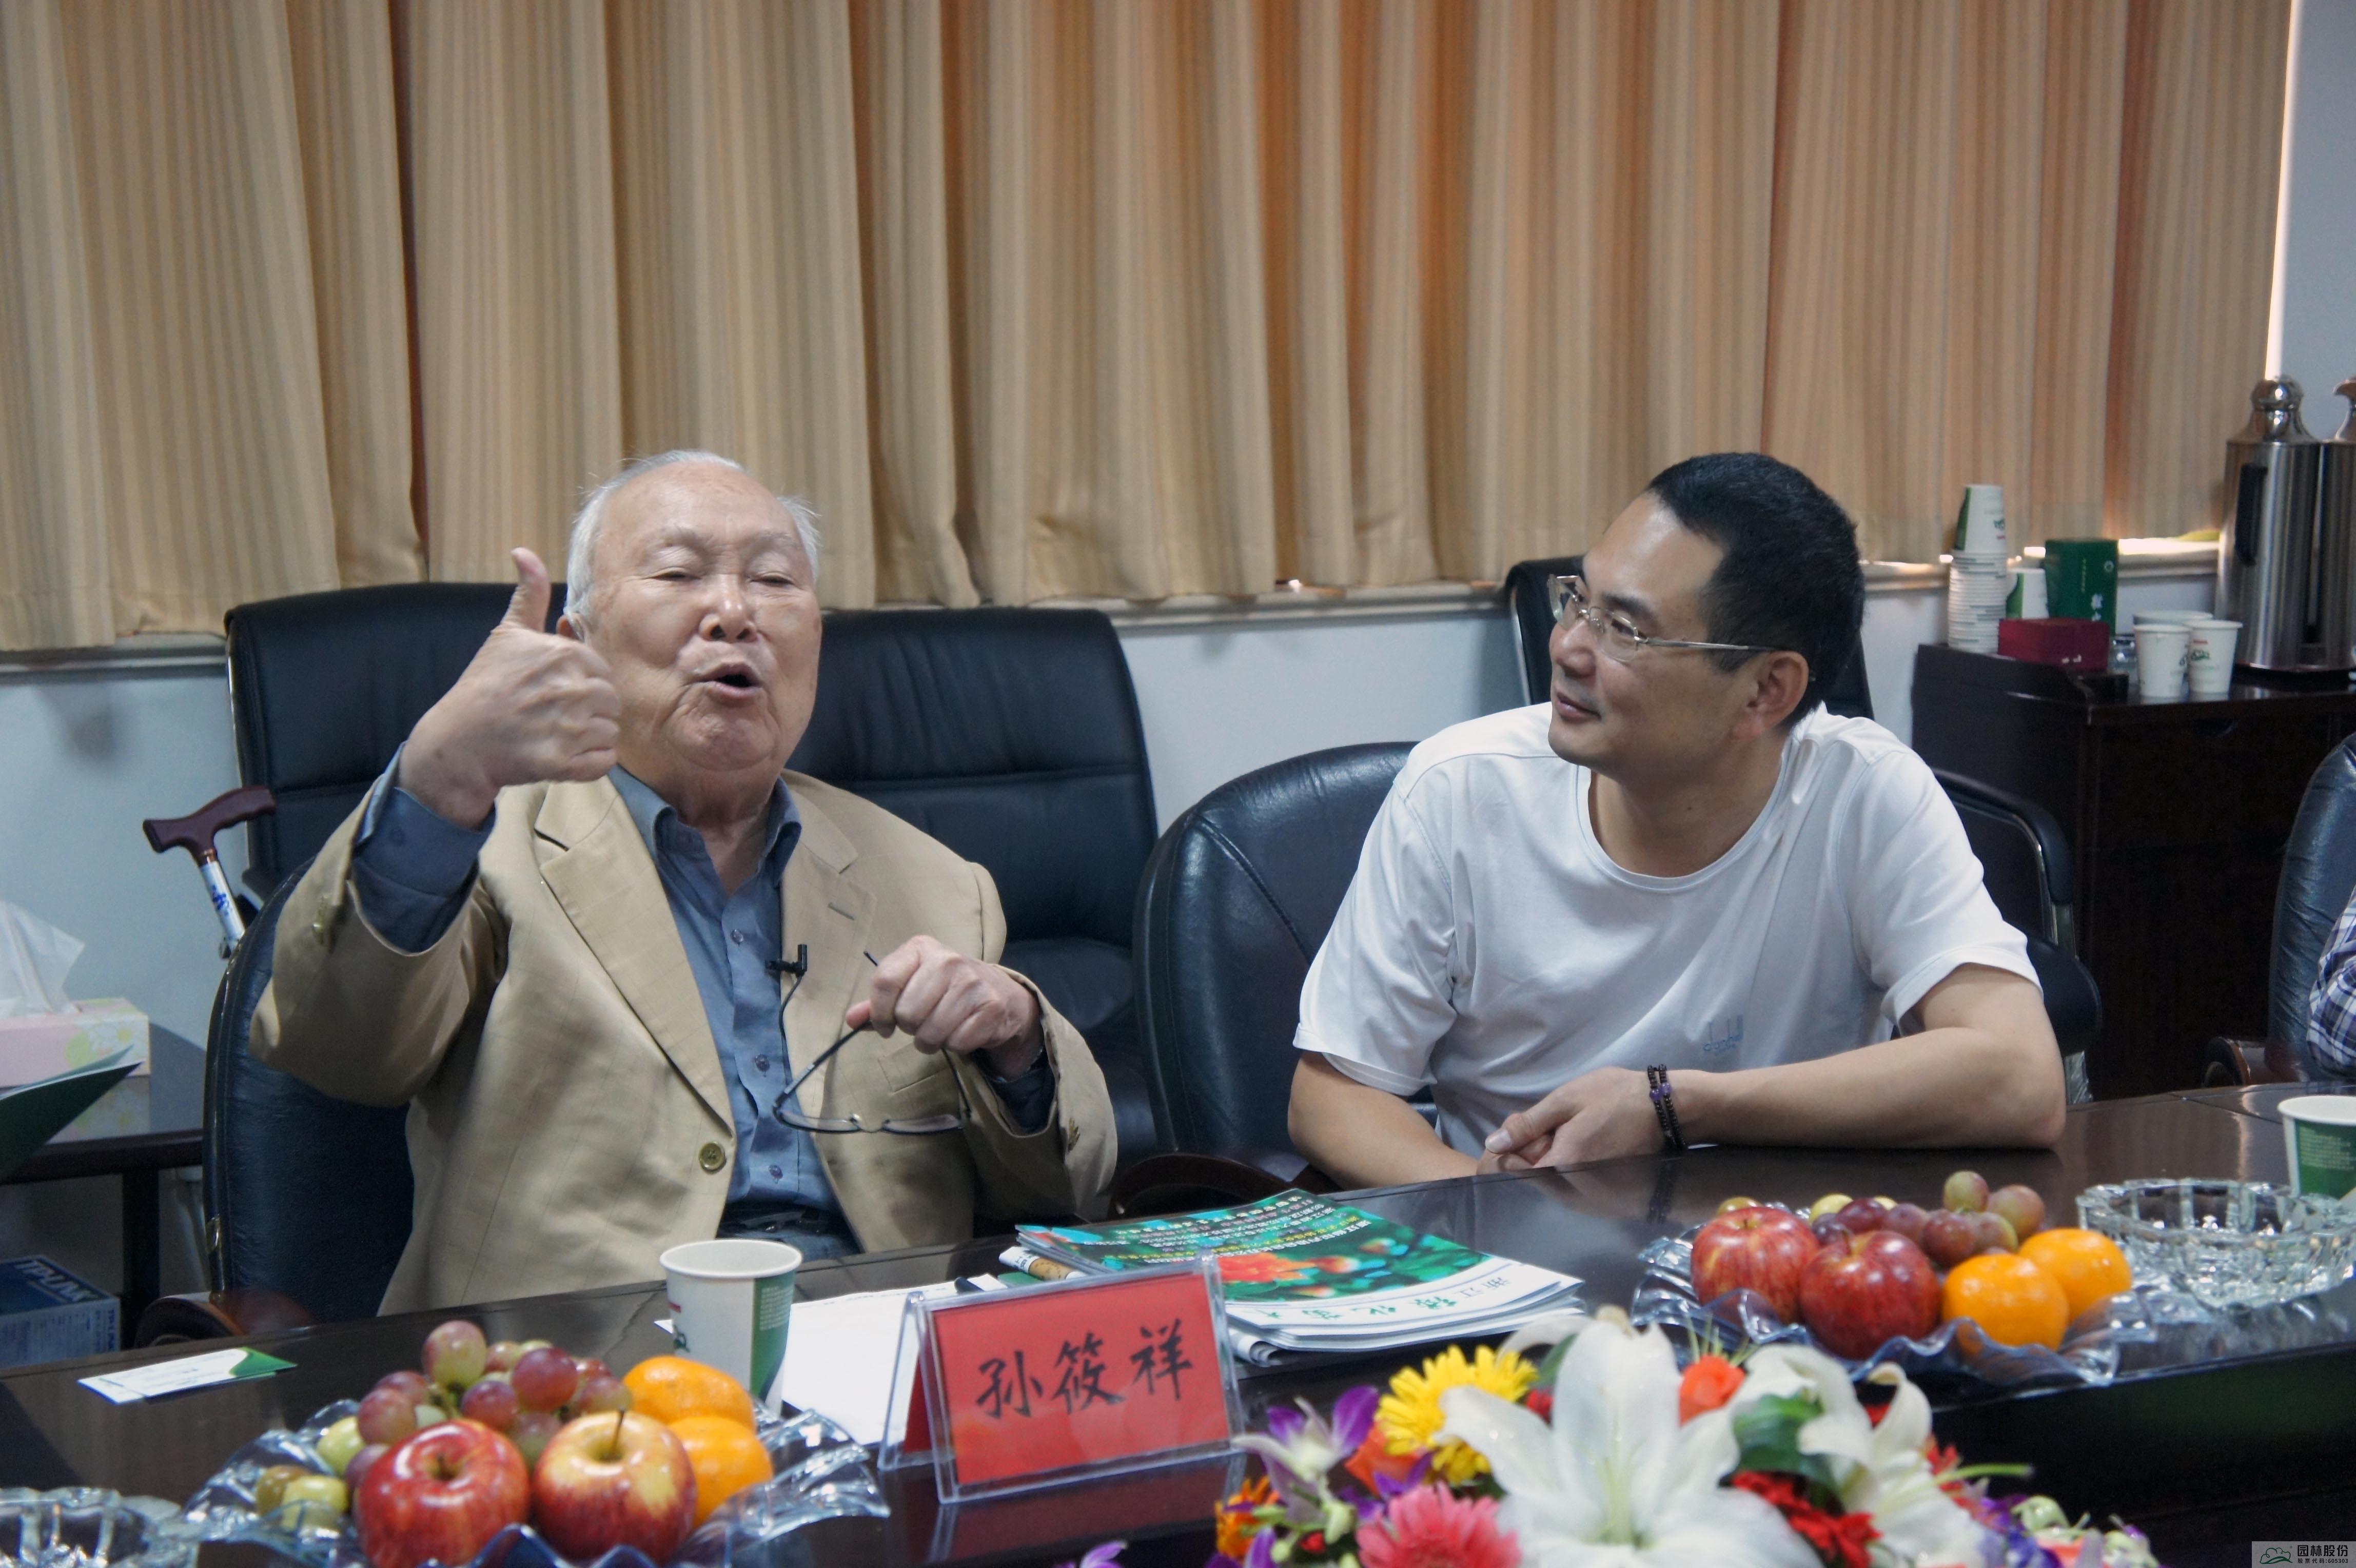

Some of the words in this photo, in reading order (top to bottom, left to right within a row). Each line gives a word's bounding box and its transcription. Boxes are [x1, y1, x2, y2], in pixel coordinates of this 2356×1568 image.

[14, 1260, 99, 1303] TP-LINK
[1455, 1276, 1511, 1298] 浙江
[975, 1318, 1193, 1420] 孙筱祥
